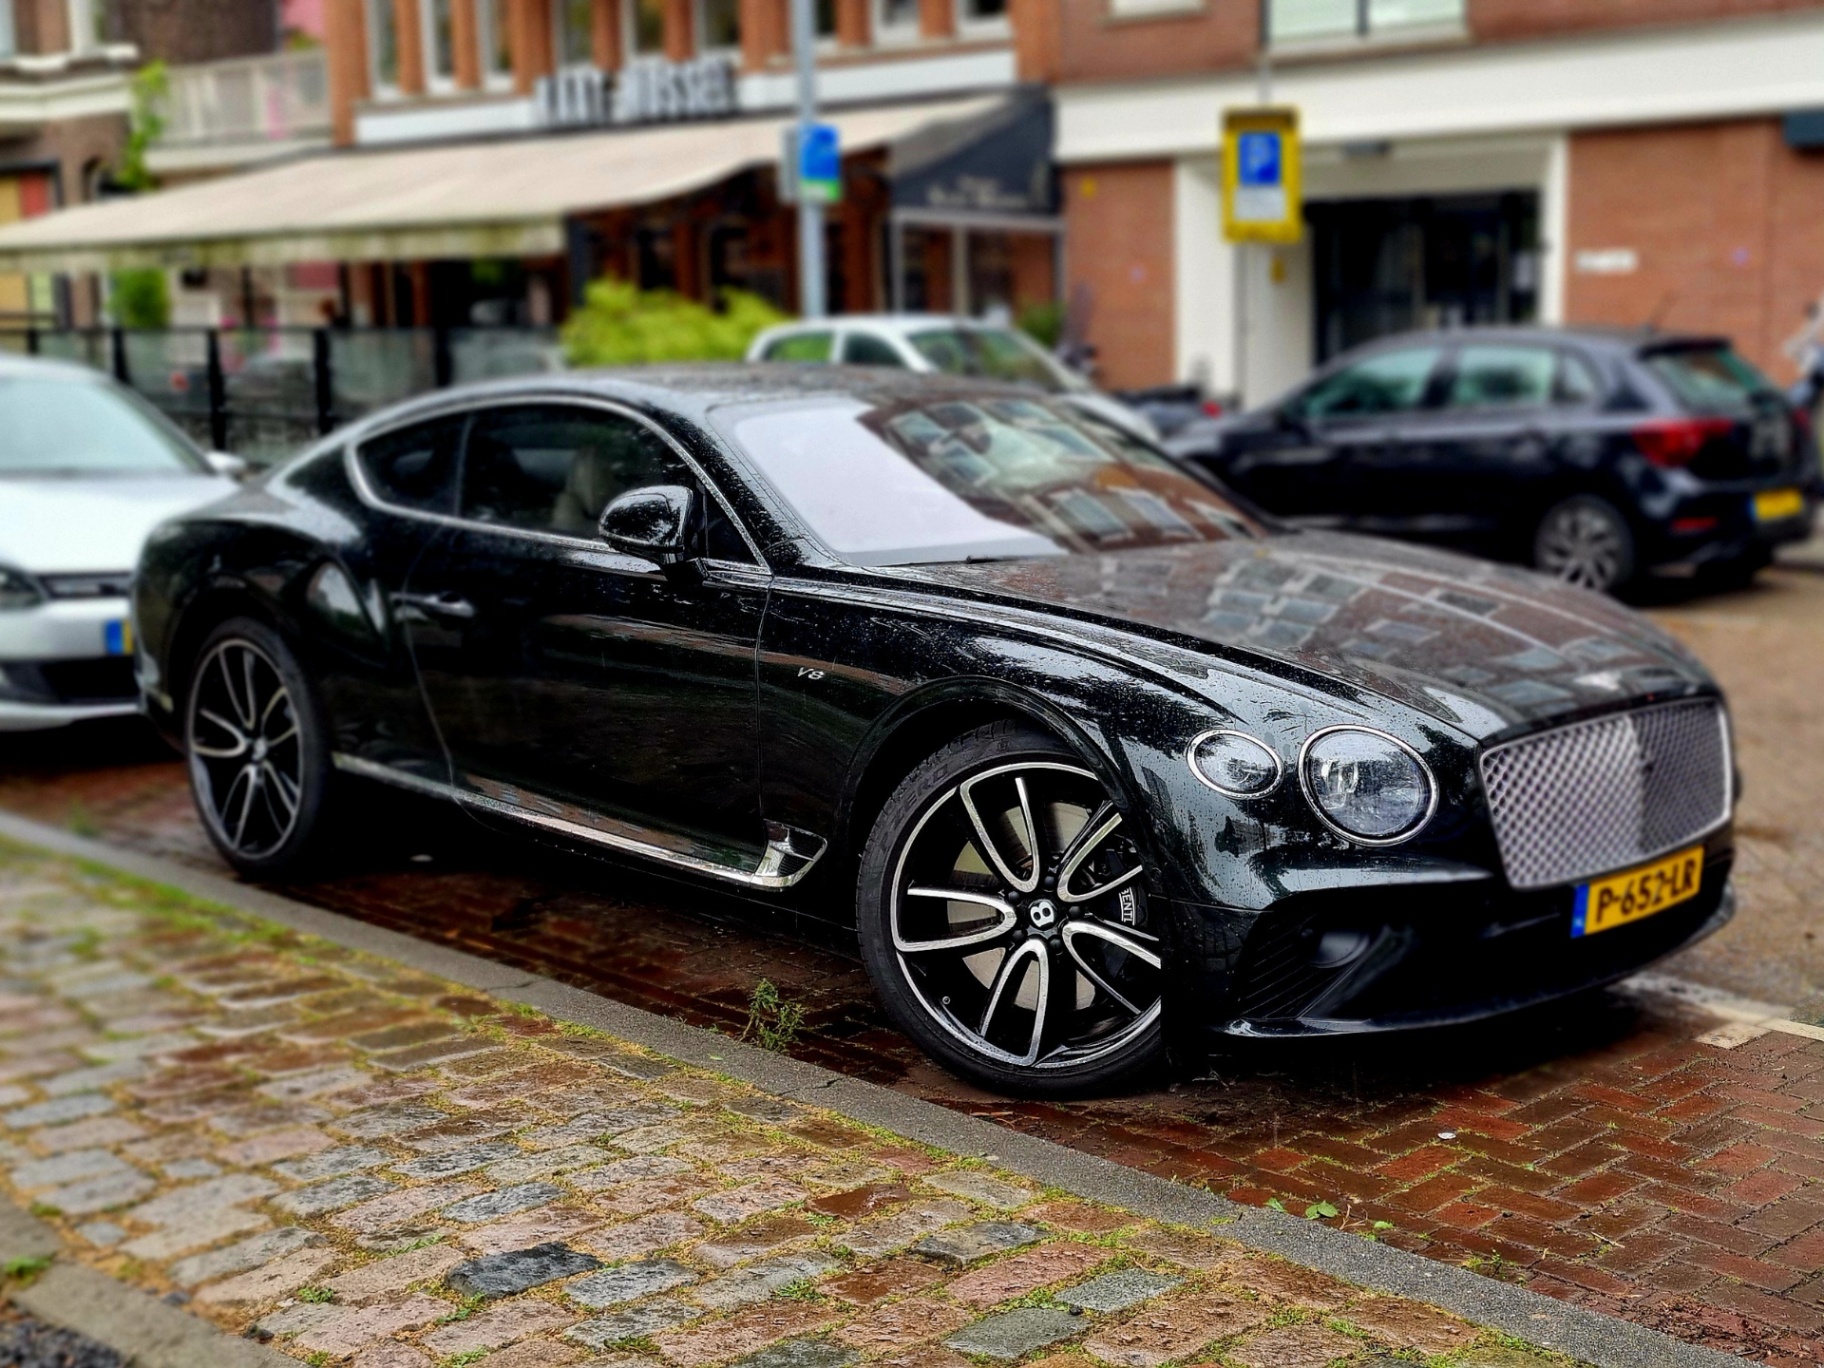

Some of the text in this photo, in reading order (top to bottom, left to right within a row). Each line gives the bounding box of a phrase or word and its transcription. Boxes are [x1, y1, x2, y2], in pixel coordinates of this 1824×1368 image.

[797, 667, 824, 680] V8
[1030, 901, 1055, 927] B
[1121, 887, 1133, 923] BENTL
